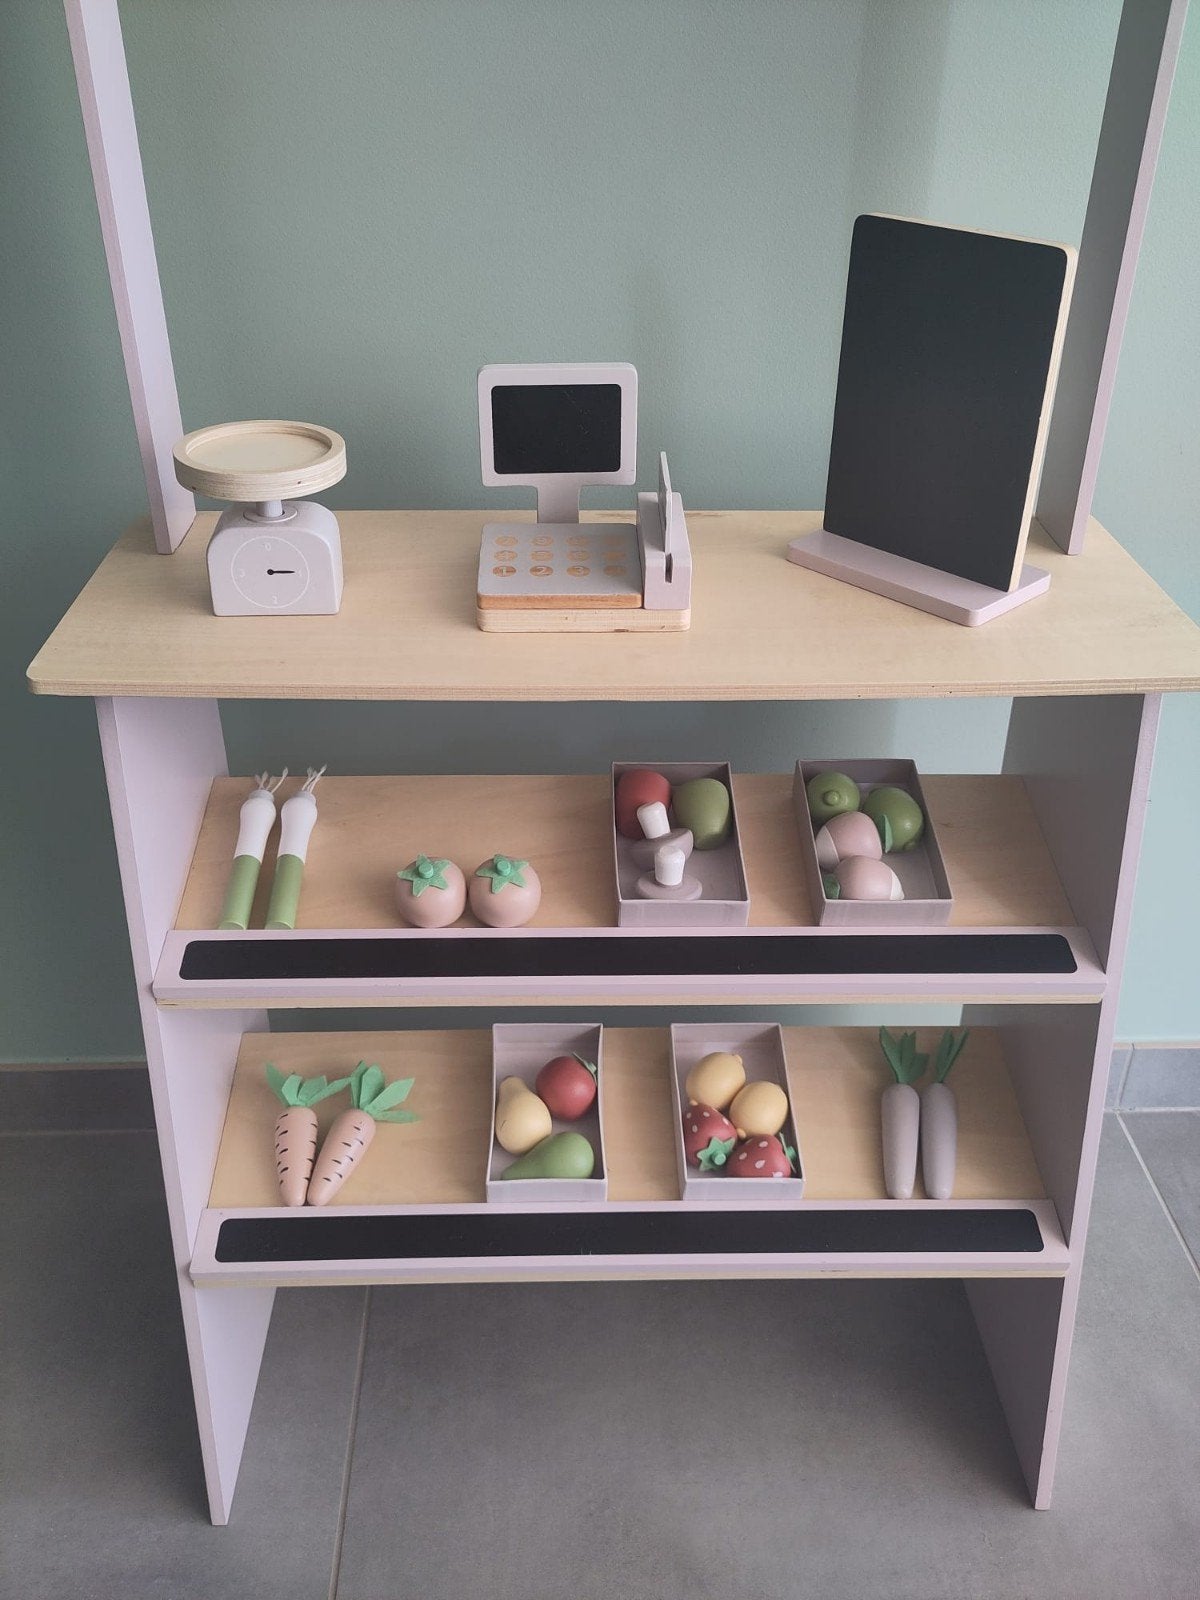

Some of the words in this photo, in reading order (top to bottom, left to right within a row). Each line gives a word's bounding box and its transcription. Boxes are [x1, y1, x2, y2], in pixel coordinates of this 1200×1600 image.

[264, 542, 272, 552] 0
[537, 566, 546, 576] 2
[575, 566, 584, 576] 3
